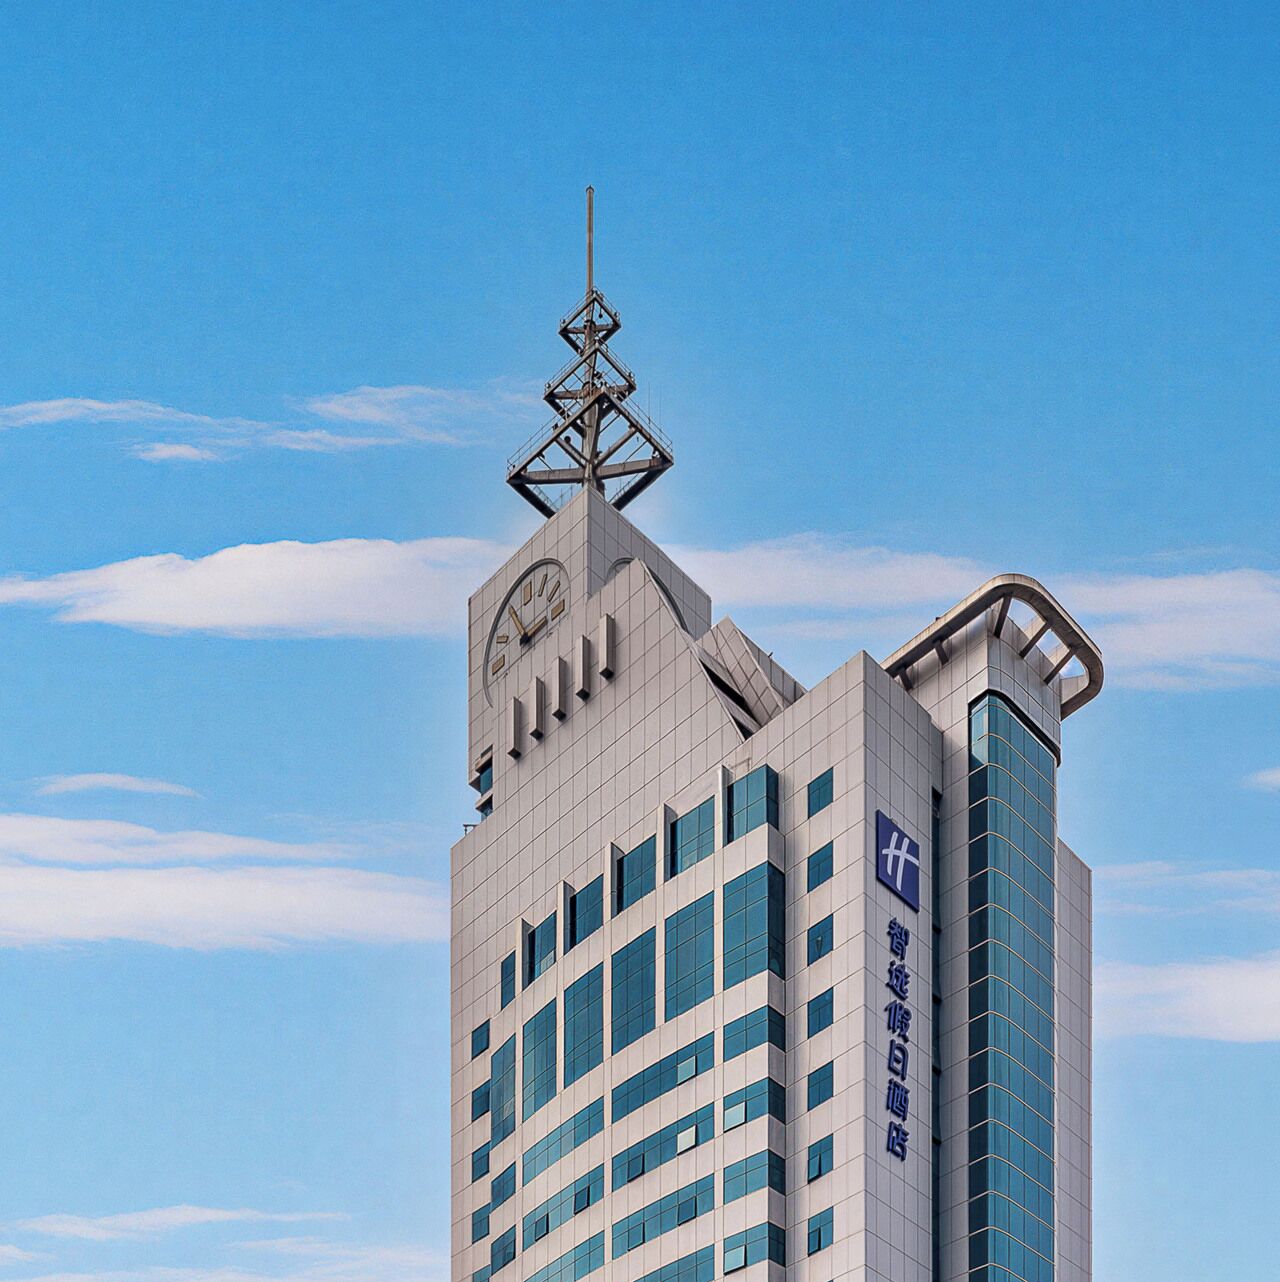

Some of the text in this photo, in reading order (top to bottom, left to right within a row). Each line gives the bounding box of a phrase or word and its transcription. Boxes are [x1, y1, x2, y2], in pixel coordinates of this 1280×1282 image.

[884, 917, 912, 1162] 智选假日酒店
